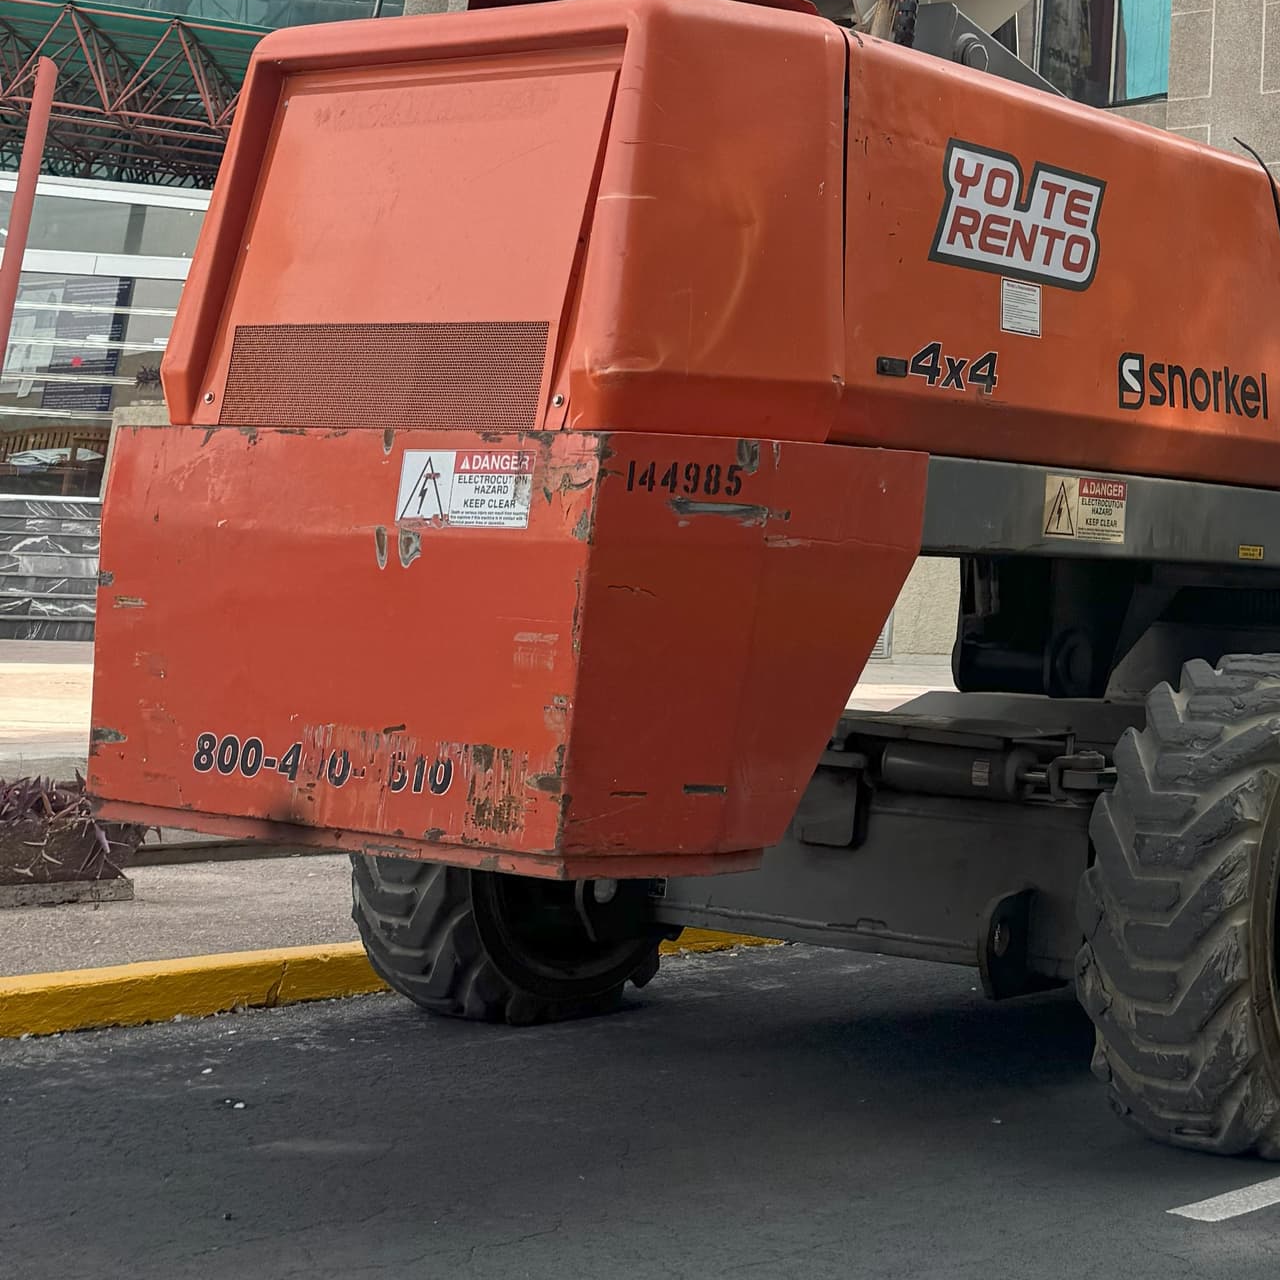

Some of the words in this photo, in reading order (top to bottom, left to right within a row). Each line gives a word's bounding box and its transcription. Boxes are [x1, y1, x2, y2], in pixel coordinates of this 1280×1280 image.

[954, 157, 1014, 208] YO
[1040, 180, 1094, 229] TE
[946, 205, 1091, 273] RENTO
[909, 341, 998, 395] 4x4
[1149, 362, 1268, 420] snorkel
[471, 454, 529, 471] DANGER
[458, 475, 527, 485] ELECTROCUTON
[474, 485, 509, 495] HAZARD
[627, 460, 742, 497] 144985
[1089, 482, 1124, 497] DANGER
[463, 498, 486, 508] KEEP
[488, 499, 516, 509] CLEAR
